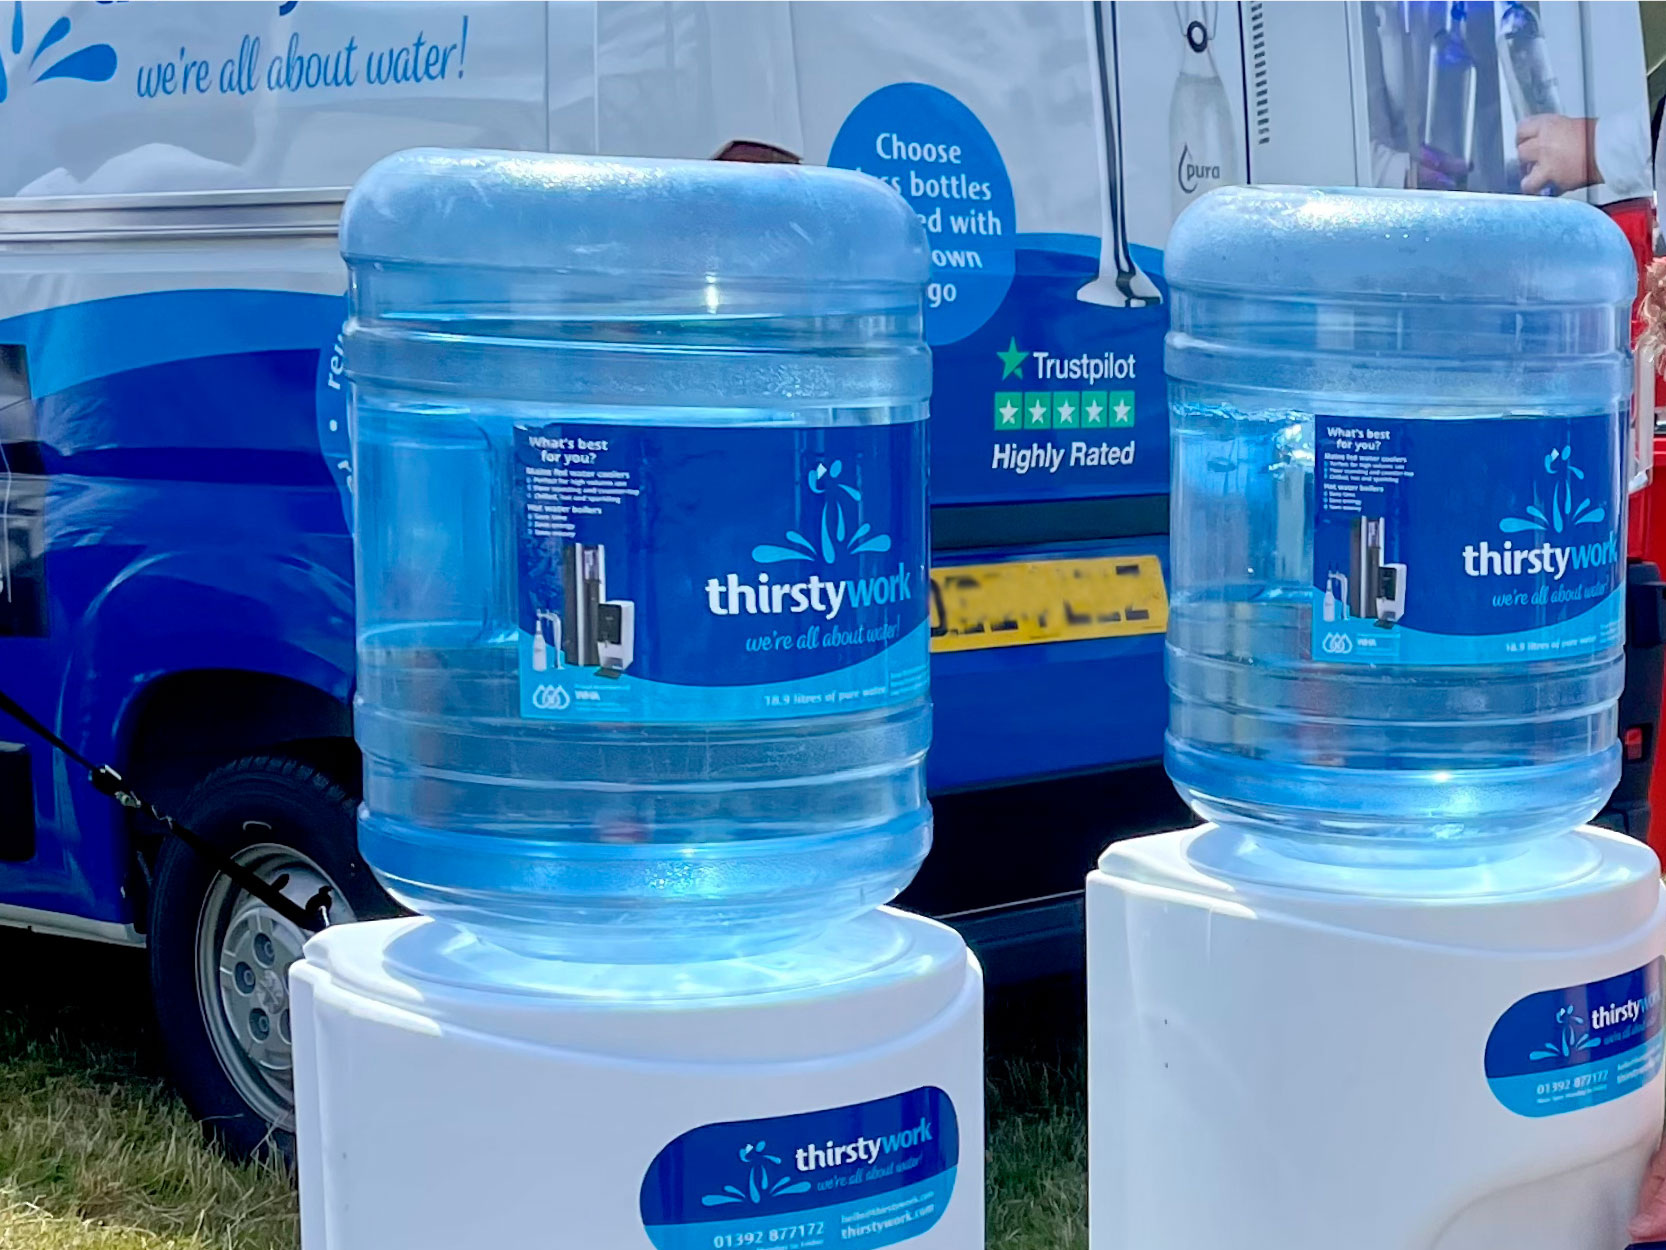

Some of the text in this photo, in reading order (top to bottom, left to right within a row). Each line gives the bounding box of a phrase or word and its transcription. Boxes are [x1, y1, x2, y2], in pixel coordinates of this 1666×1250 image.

[137, 15, 469, 98] we're all about water!
[876, 133, 961, 164] Choose
[910, 170, 992, 201] bottles
[1187, 164, 1220, 181] pura
[950, 209, 1002, 236] with
[931, 249, 983, 268] own
[927, 283, 956, 308] go
[1033, 352, 1136, 385] Trustpilot
[529, 436, 608, 451] What's best
[1327, 427, 1390, 440] What's best
[1336, 438, 1381, 452] for you?
[541, 450, 597, 466] for you?
[992, 441, 1135, 474] Highly Rated
[1463, 537, 1617, 580] thirstywork
[705, 563, 911, 619] thirstywork
[1492, 588, 1529, 607] we're
[1531, 584, 1549, 605] all
[746, 630, 794, 651] we're
[797, 625, 820, 650] all
[822, 624, 864, 647] about
[796, 1117, 932, 1171] thirstywork
[713, 1221, 824, 1249] 01392 877172
